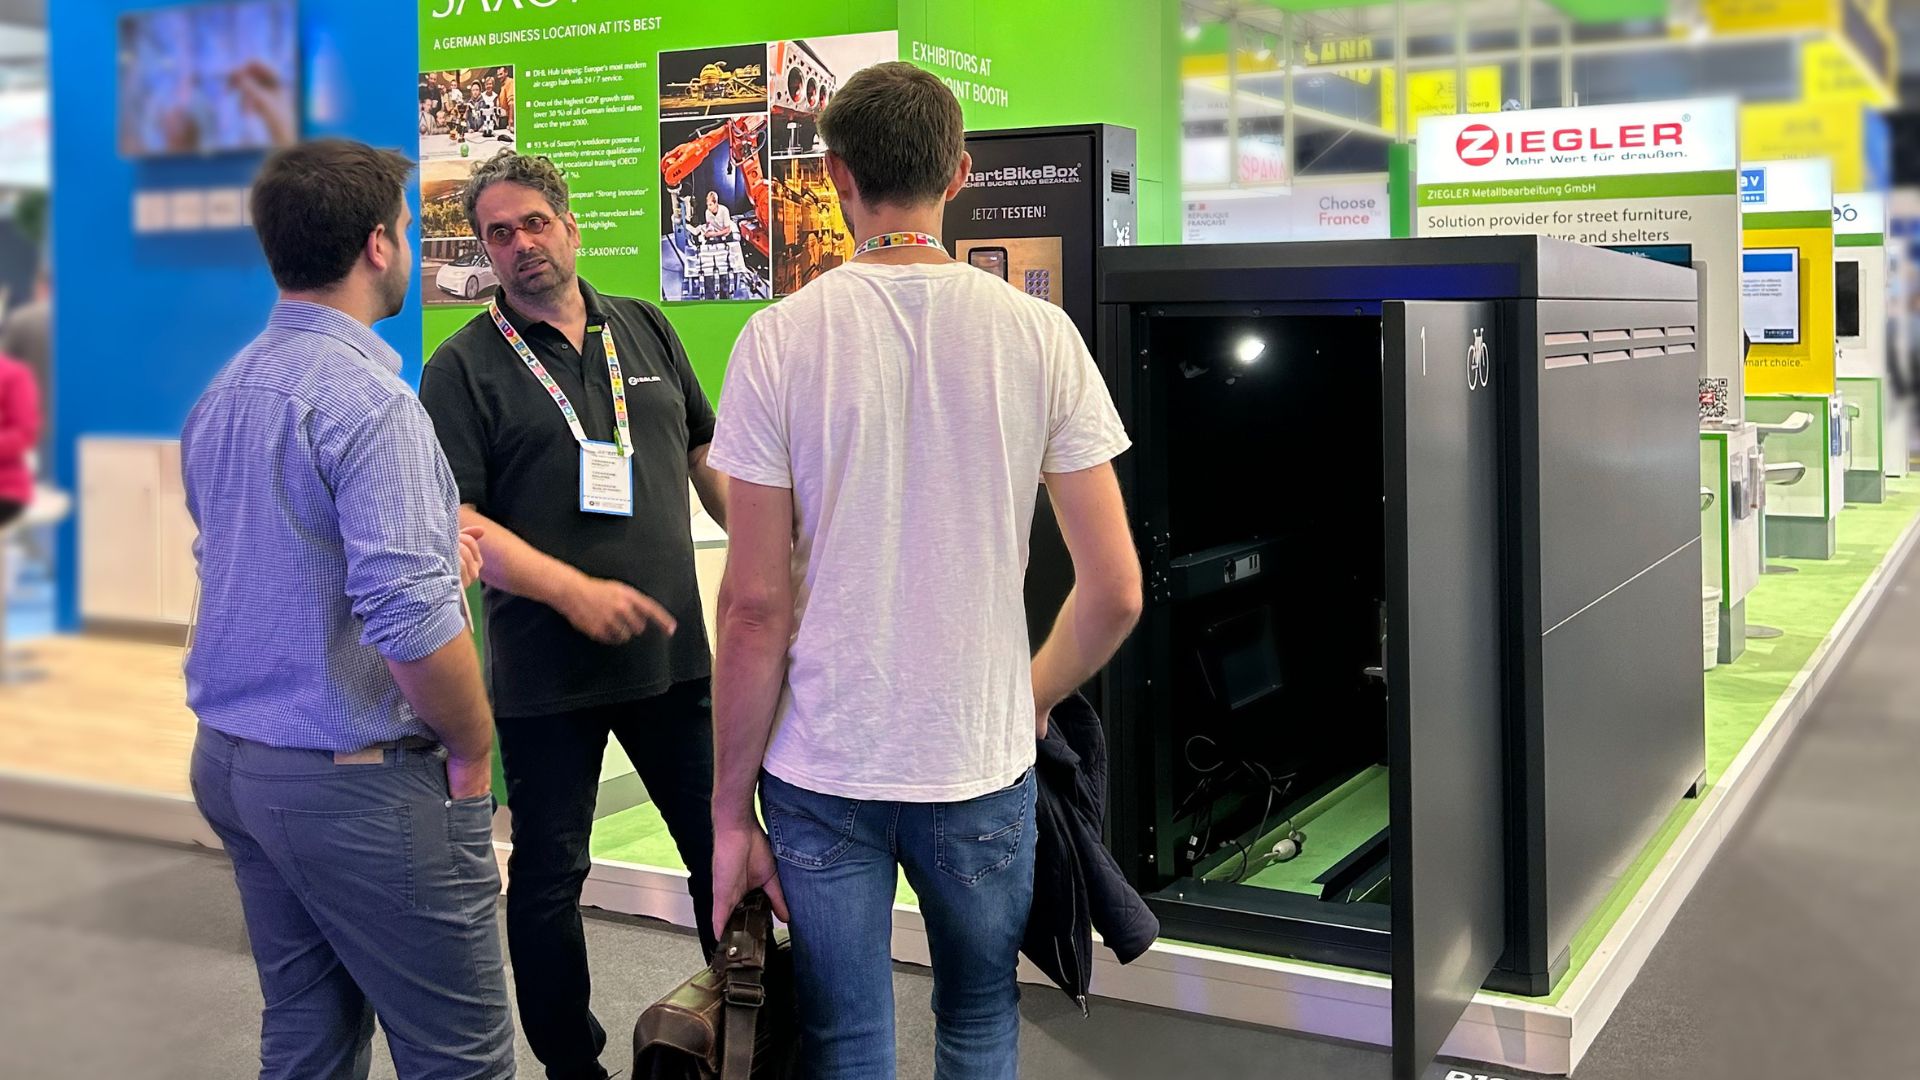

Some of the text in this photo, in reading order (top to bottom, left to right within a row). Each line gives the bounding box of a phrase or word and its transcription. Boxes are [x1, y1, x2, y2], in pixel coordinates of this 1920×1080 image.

[433, 16, 662, 51] A GERMAN BUSINESS LOCATION AT ITS BEST
[624, 61, 647, 70] modern
[912, 41, 992, 77] EXHIBITORS AT
[940, 76, 1009, 108] OINT BOOTH
[1505, 150, 1688, 166] Mehr Wert für draußen.
[987, 179, 1019, 188] BUCHEN
[1020, 178, 1037, 186] UND
[1426, 182, 1596, 200] ZIEGLER Metallbearbeitung GmbH
[1319, 196, 1376, 211] Choose
[971, 205, 1047, 220] JETZT TESTEN!
[1319, 212, 1370, 226] France
[1428, 207, 1692, 229] Solution provider for street furniture,
[1579, 229, 1607, 243] and
[1611, 228, 1670, 243] shelters
[576, 246, 639, 257] SS-SAXONY.COM
[1769, 358, 1803, 368] choice.
